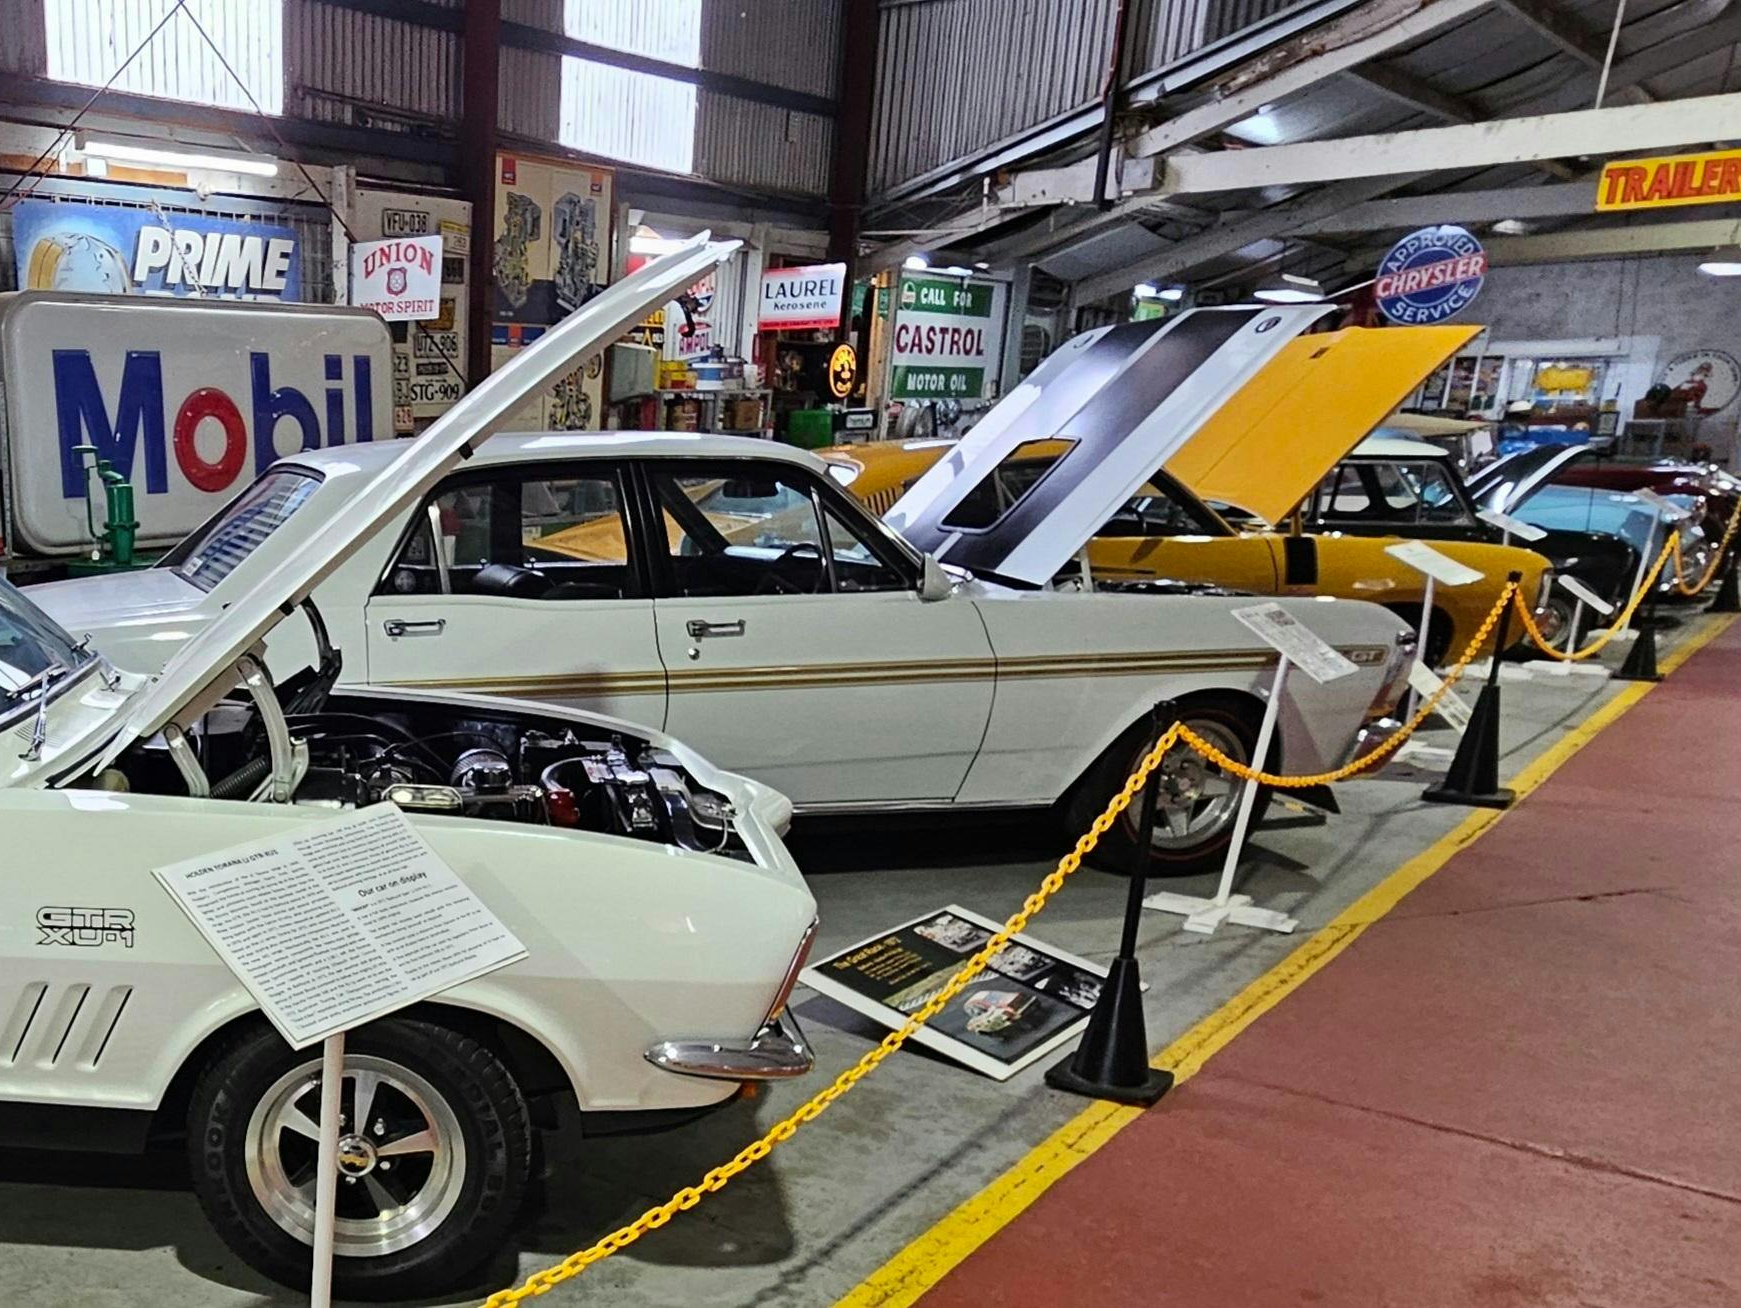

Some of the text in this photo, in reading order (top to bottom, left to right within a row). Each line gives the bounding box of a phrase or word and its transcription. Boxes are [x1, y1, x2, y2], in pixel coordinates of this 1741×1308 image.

[134, 225, 295, 291] PRIME
[363, 241, 435, 279] UNION
[1387, 233, 1475, 272] APPROVED
[765, 279, 838, 299] LAUREL
[1376, 256, 1484, 298] CHRYSLER
[396, 300, 434, 313] SPIRIT
[773, 300, 827, 311] Kerosene
[920, 287, 973, 308] CALL FOR
[1392, 285, 1475, 322] SERVICE
[896, 324, 984, 356] CASTROL
[410, 383, 460, 401] STG-909
[907, 373, 967, 391] MOTOR OIL
[52, 349, 374, 499] Mobil
[185, 866, 214, 880] HOLDEN
[214, 860, 242, 872] TORANA
[250, 852, 264, 862] GTR
[358, 871, 427, 898] Our car on display
[36, 905, 135, 930] GTR
